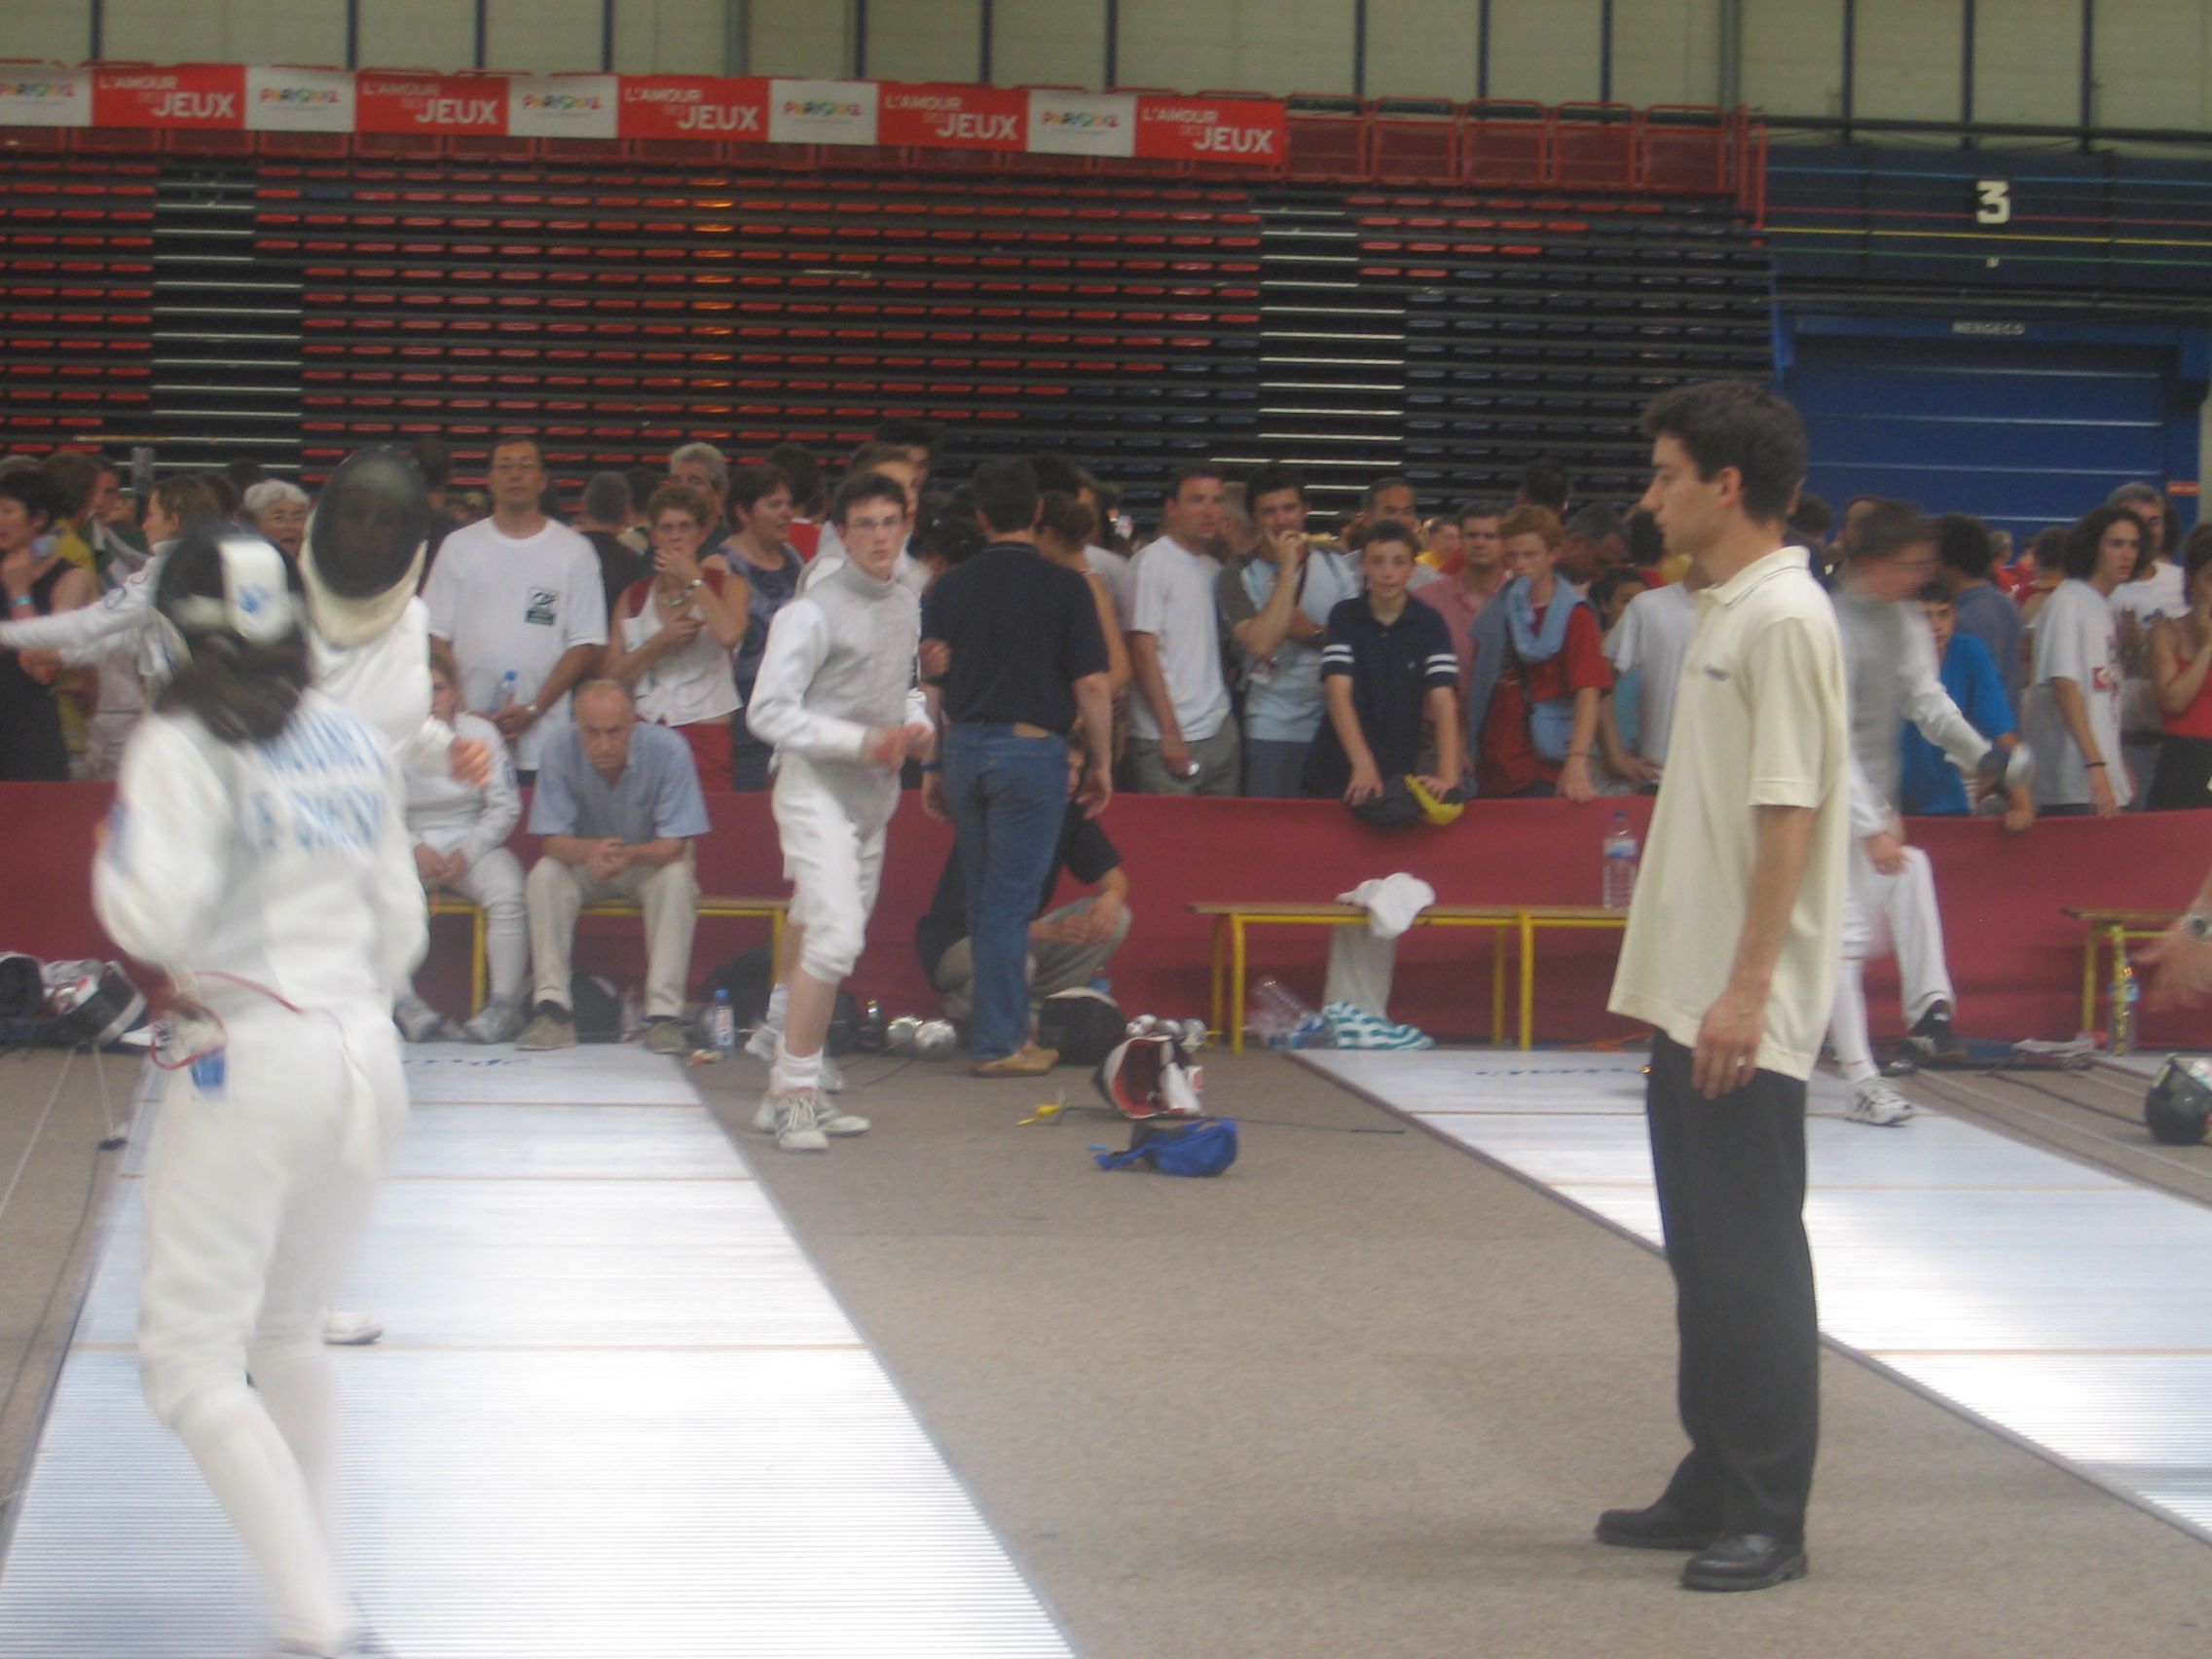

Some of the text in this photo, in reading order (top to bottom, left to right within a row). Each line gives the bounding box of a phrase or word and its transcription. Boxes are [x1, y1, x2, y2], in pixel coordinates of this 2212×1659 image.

[151, 92, 236, 119] JEUX
[625, 88, 703, 102] L'AMOUR
[885, 95, 962, 110] L'AMOUR
[415, 99, 498, 125] JEUX
[677, 105, 758, 130] JEUX
[1142, 106, 1218, 123] L'AMOUR
[937, 114, 1018, 140] JEUX
[1193, 128, 1274, 154] JEUX
[1976, 180, 2010, 224] 3
